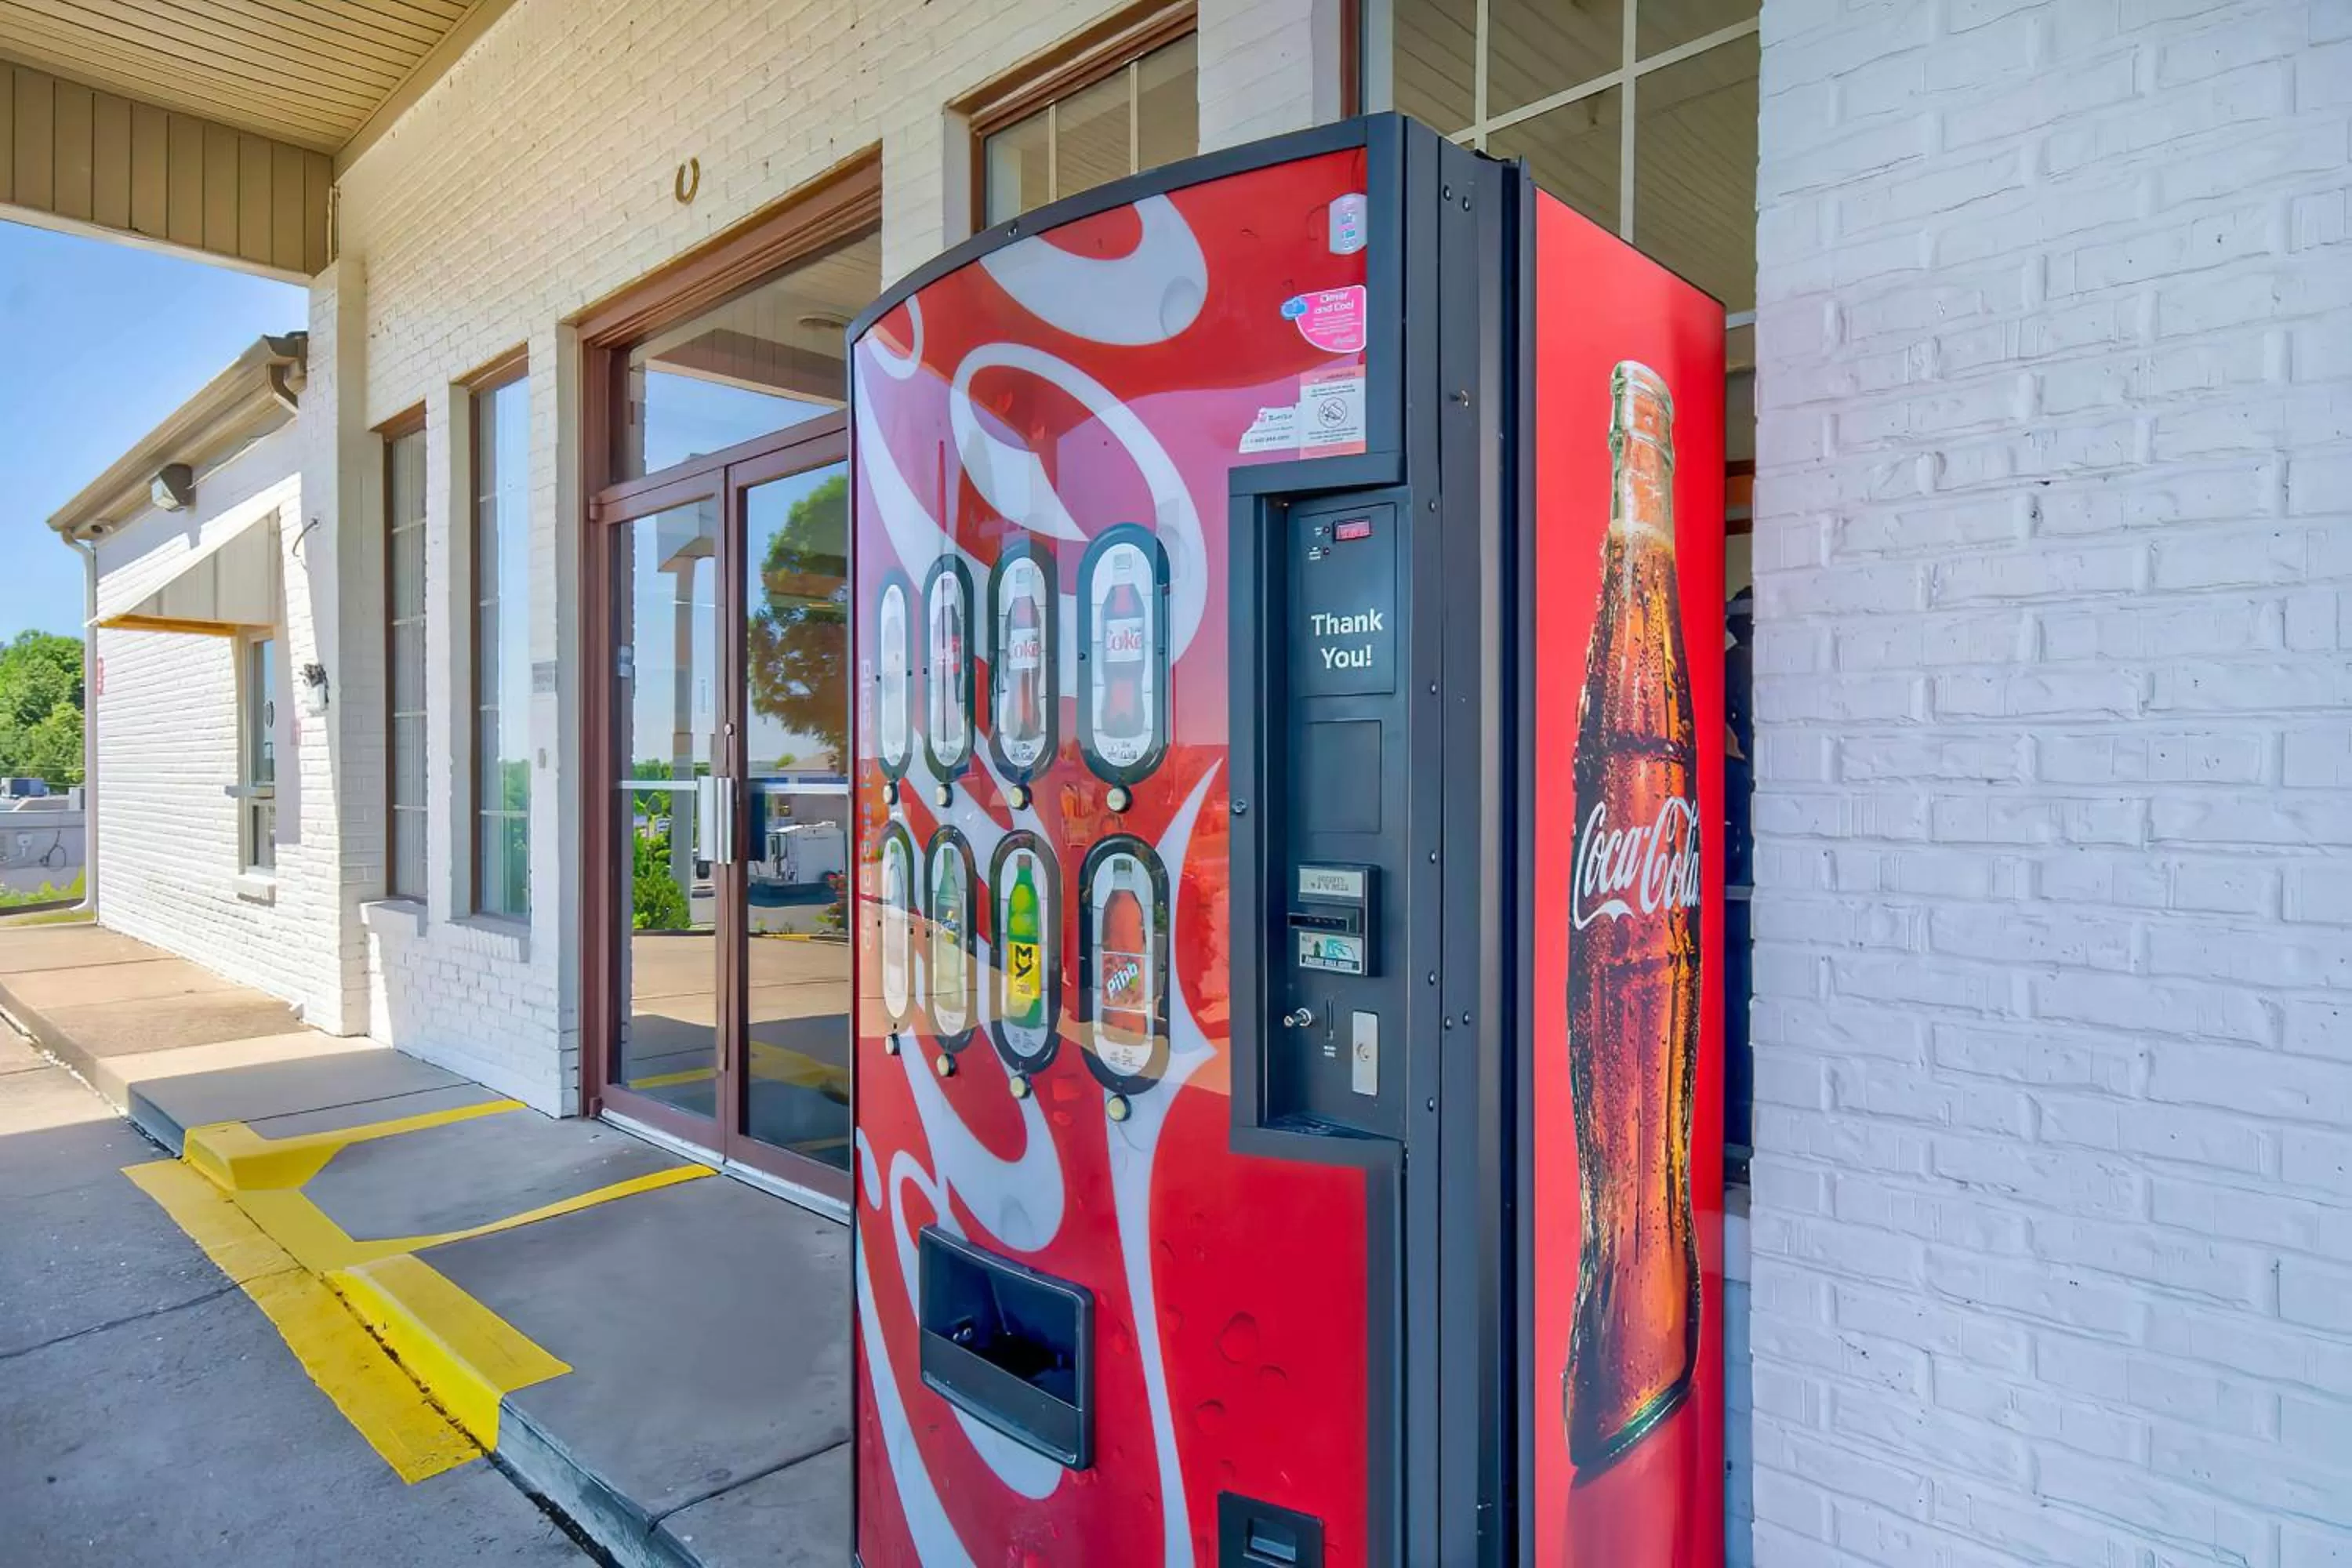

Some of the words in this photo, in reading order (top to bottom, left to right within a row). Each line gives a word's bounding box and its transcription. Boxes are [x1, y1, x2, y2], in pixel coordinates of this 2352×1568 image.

[1310, 608, 1384, 637] Thank
[1320, 644, 1372, 669] You!
[1573, 796, 1700, 931] Coca-Cola
